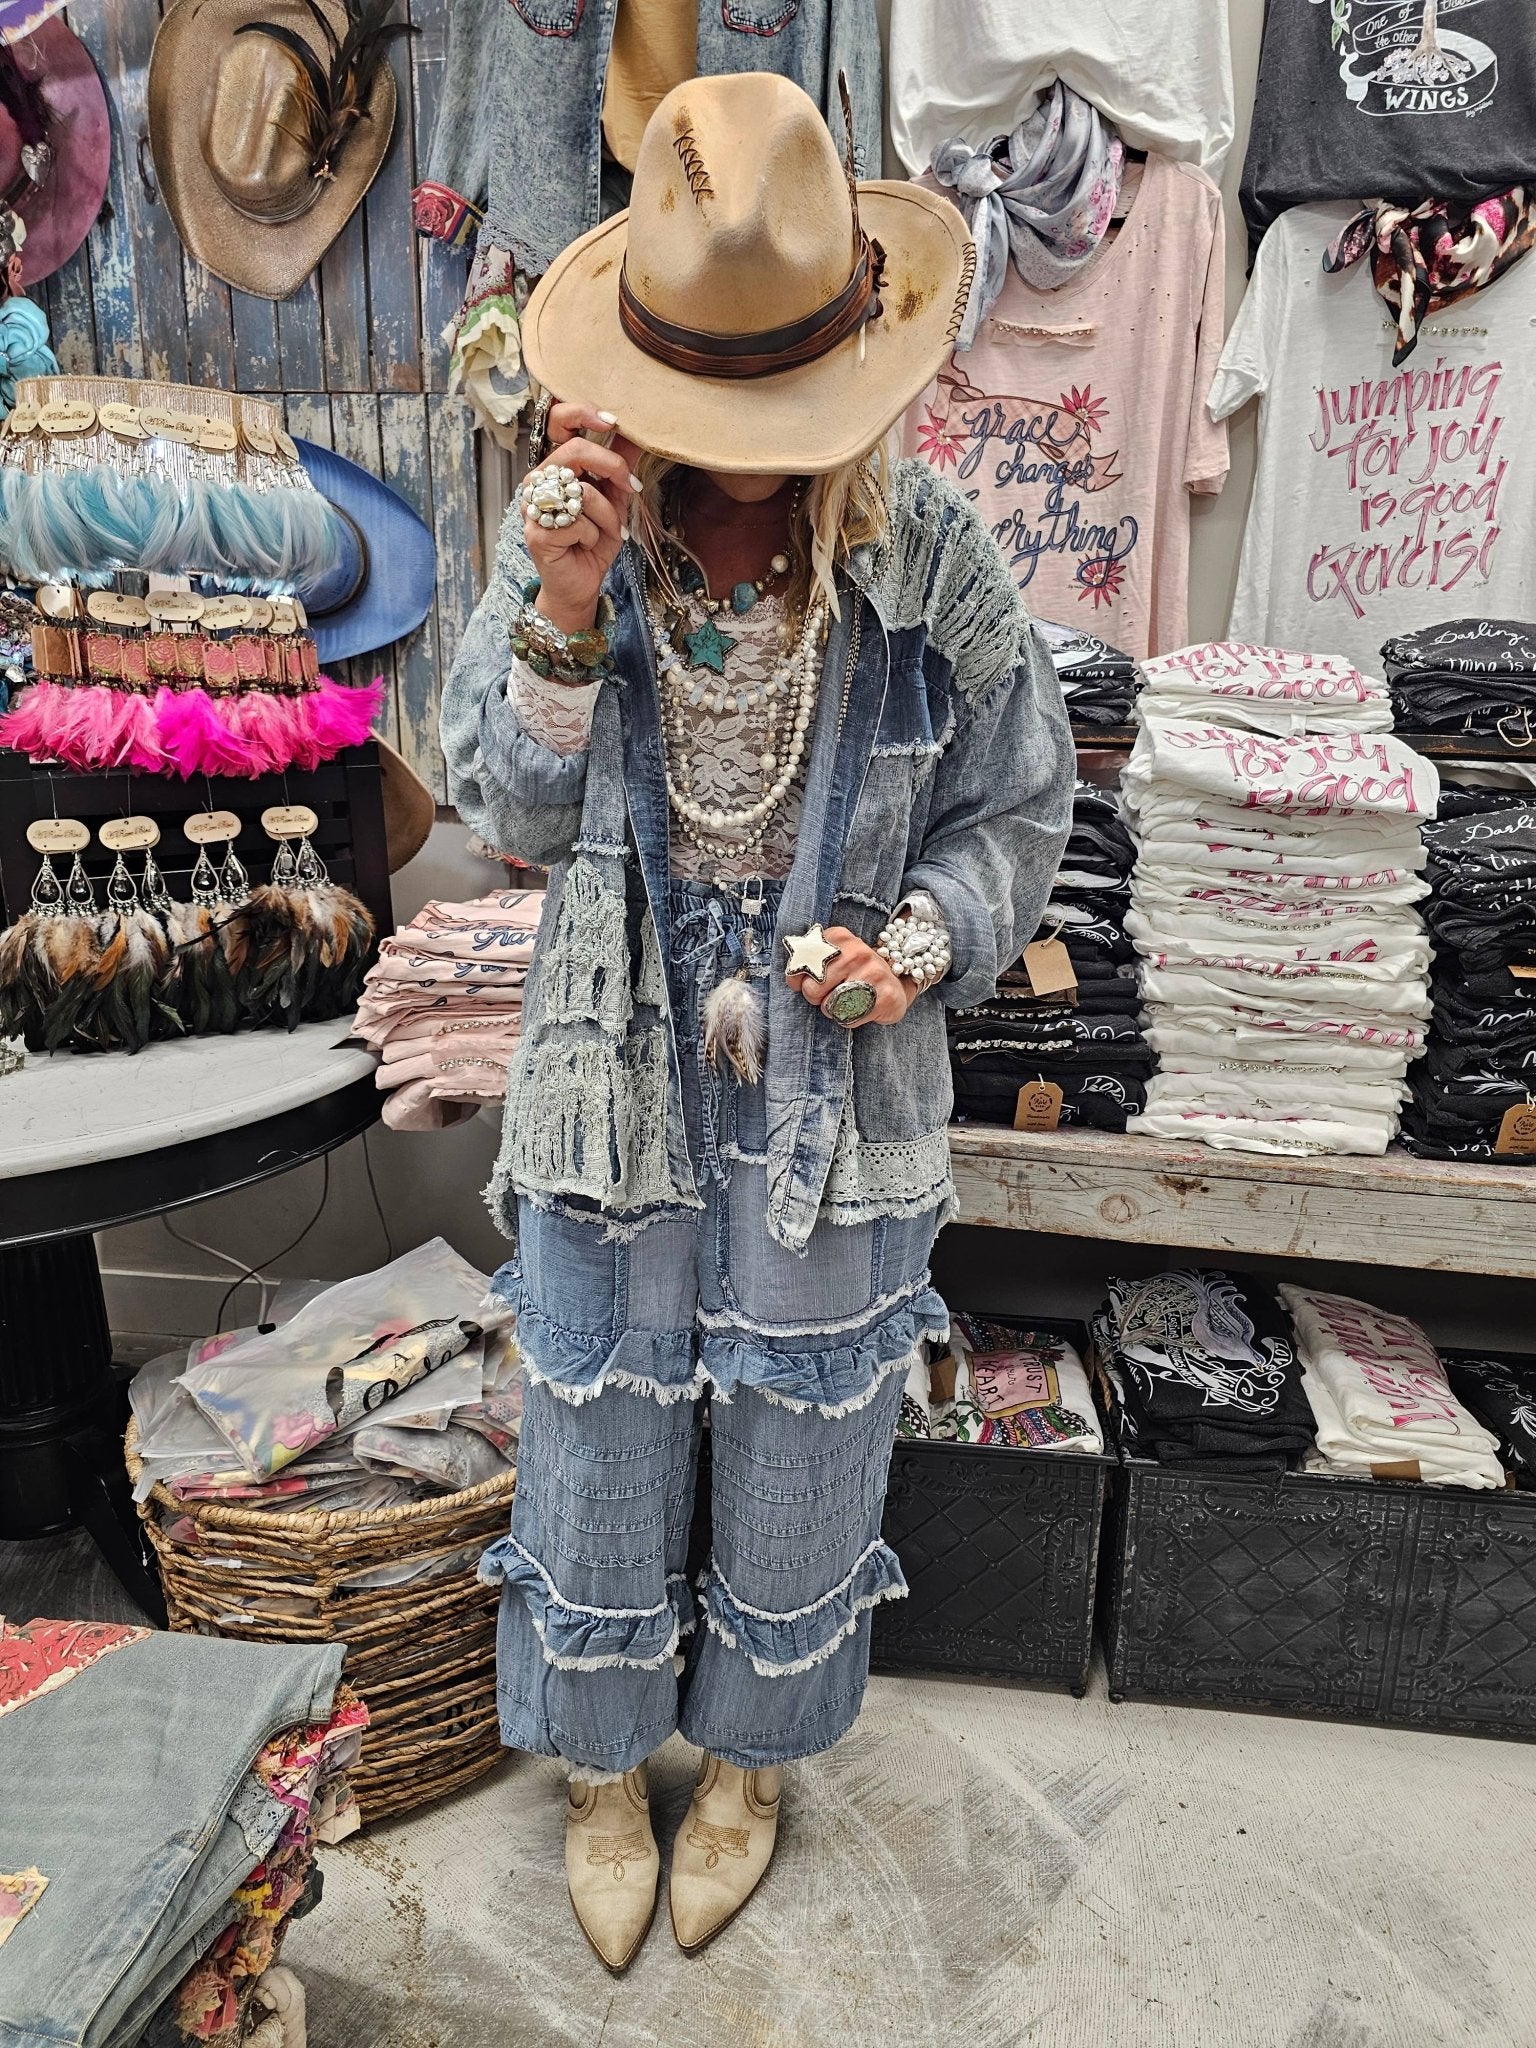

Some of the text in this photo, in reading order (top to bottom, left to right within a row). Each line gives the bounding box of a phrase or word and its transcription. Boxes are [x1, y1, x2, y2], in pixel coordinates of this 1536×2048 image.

[1365, 3, 1414, 35] One of
[1374, 33, 1390, 48] the
[1384, 87, 1469, 110] WINGS
[958, 403, 1081, 479] grace
[1360, 456, 1509, 549] is good
[964, 489, 1138, 589] erything
[1501, 651, 1513, 660] a
[1508, 660, 1524, 672] is
[1299, 763, 1419, 813] good
[1461, 815, 1536, 843] Darli
[976, 1360, 1004, 1404] HEART
[1020, 1356, 1043, 1394] TRUST
